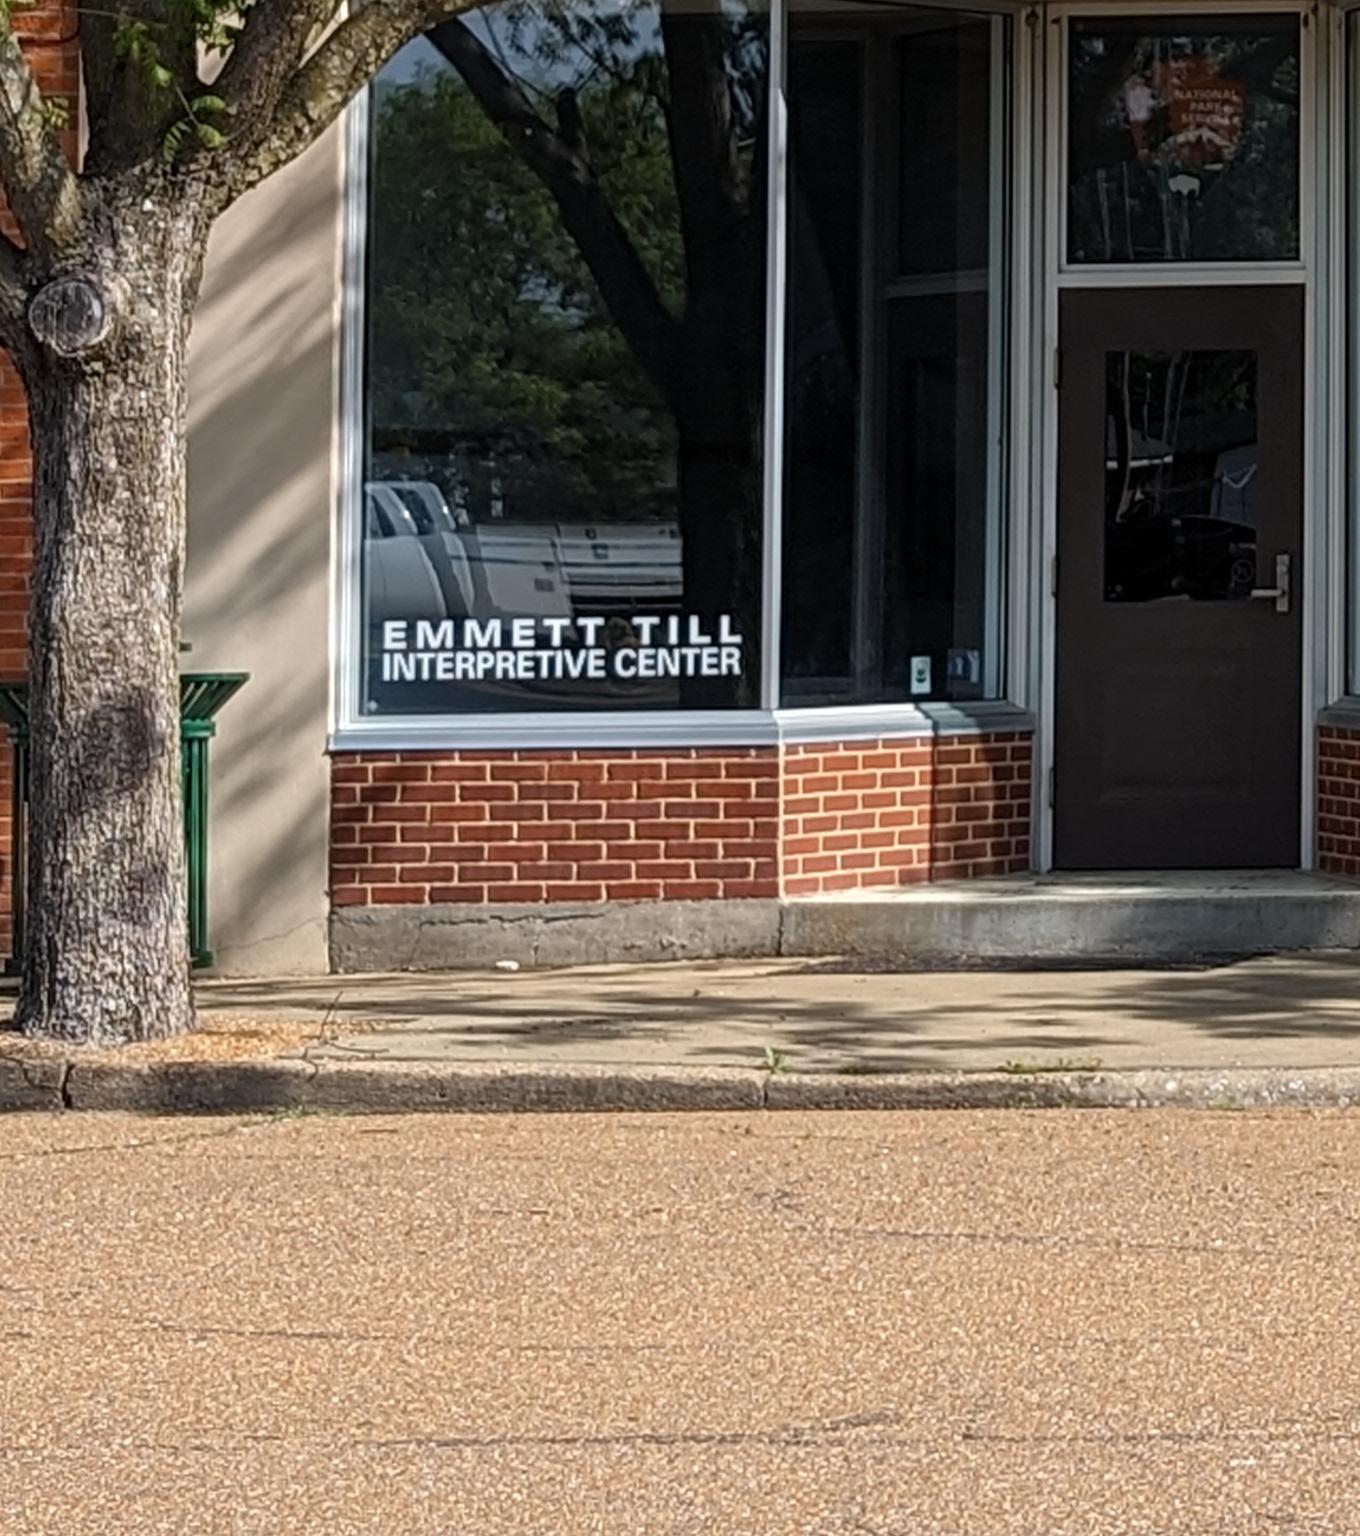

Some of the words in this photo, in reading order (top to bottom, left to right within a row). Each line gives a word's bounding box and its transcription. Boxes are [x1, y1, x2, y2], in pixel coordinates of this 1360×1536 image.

[383, 617, 605, 650] EMMETT
[630, 614, 744, 647] TILL
[383, 649, 606, 682] INTERPRETIVE
[614, 646, 742, 678] CENTER
